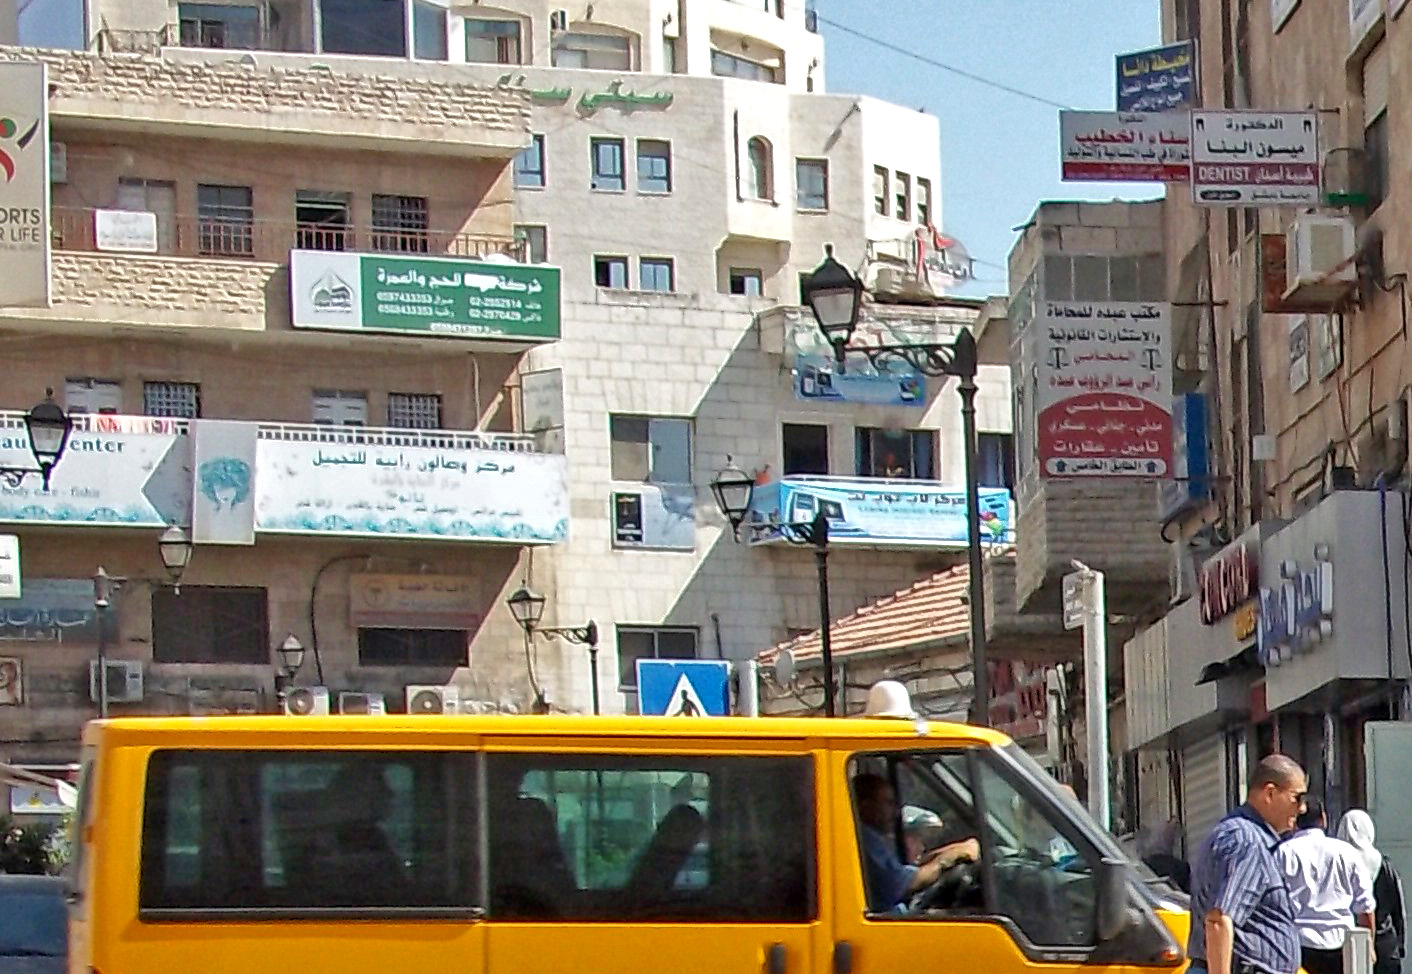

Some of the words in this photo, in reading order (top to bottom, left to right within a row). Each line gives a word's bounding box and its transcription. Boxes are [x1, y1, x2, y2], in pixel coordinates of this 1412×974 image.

[1226, 117, 1284, 131] الدكتورة
[1256, 142, 1305, 158] ميسون
[1200, 166, 1250, 181] DENTIST
[0, 207, 41, 225] ORTS
[11, 227, 40, 242] LIFE
[377, 267, 426, 287] والعمرة
[498, 275, 543, 294] شركة
[1047, 303, 1093, 318] للمحاماة
[1131, 305, 1161, 322] مكتب
[1048, 328, 1095, 344] القانونية
[1098, 328, 1161, 344] والاستشارات
[70, 438, 126, 453] enter
[1053, 439, 1105, 455] عقارات
[312, 449, 367, 468] للتجميل
[474, 458, 516, 475] مركز
